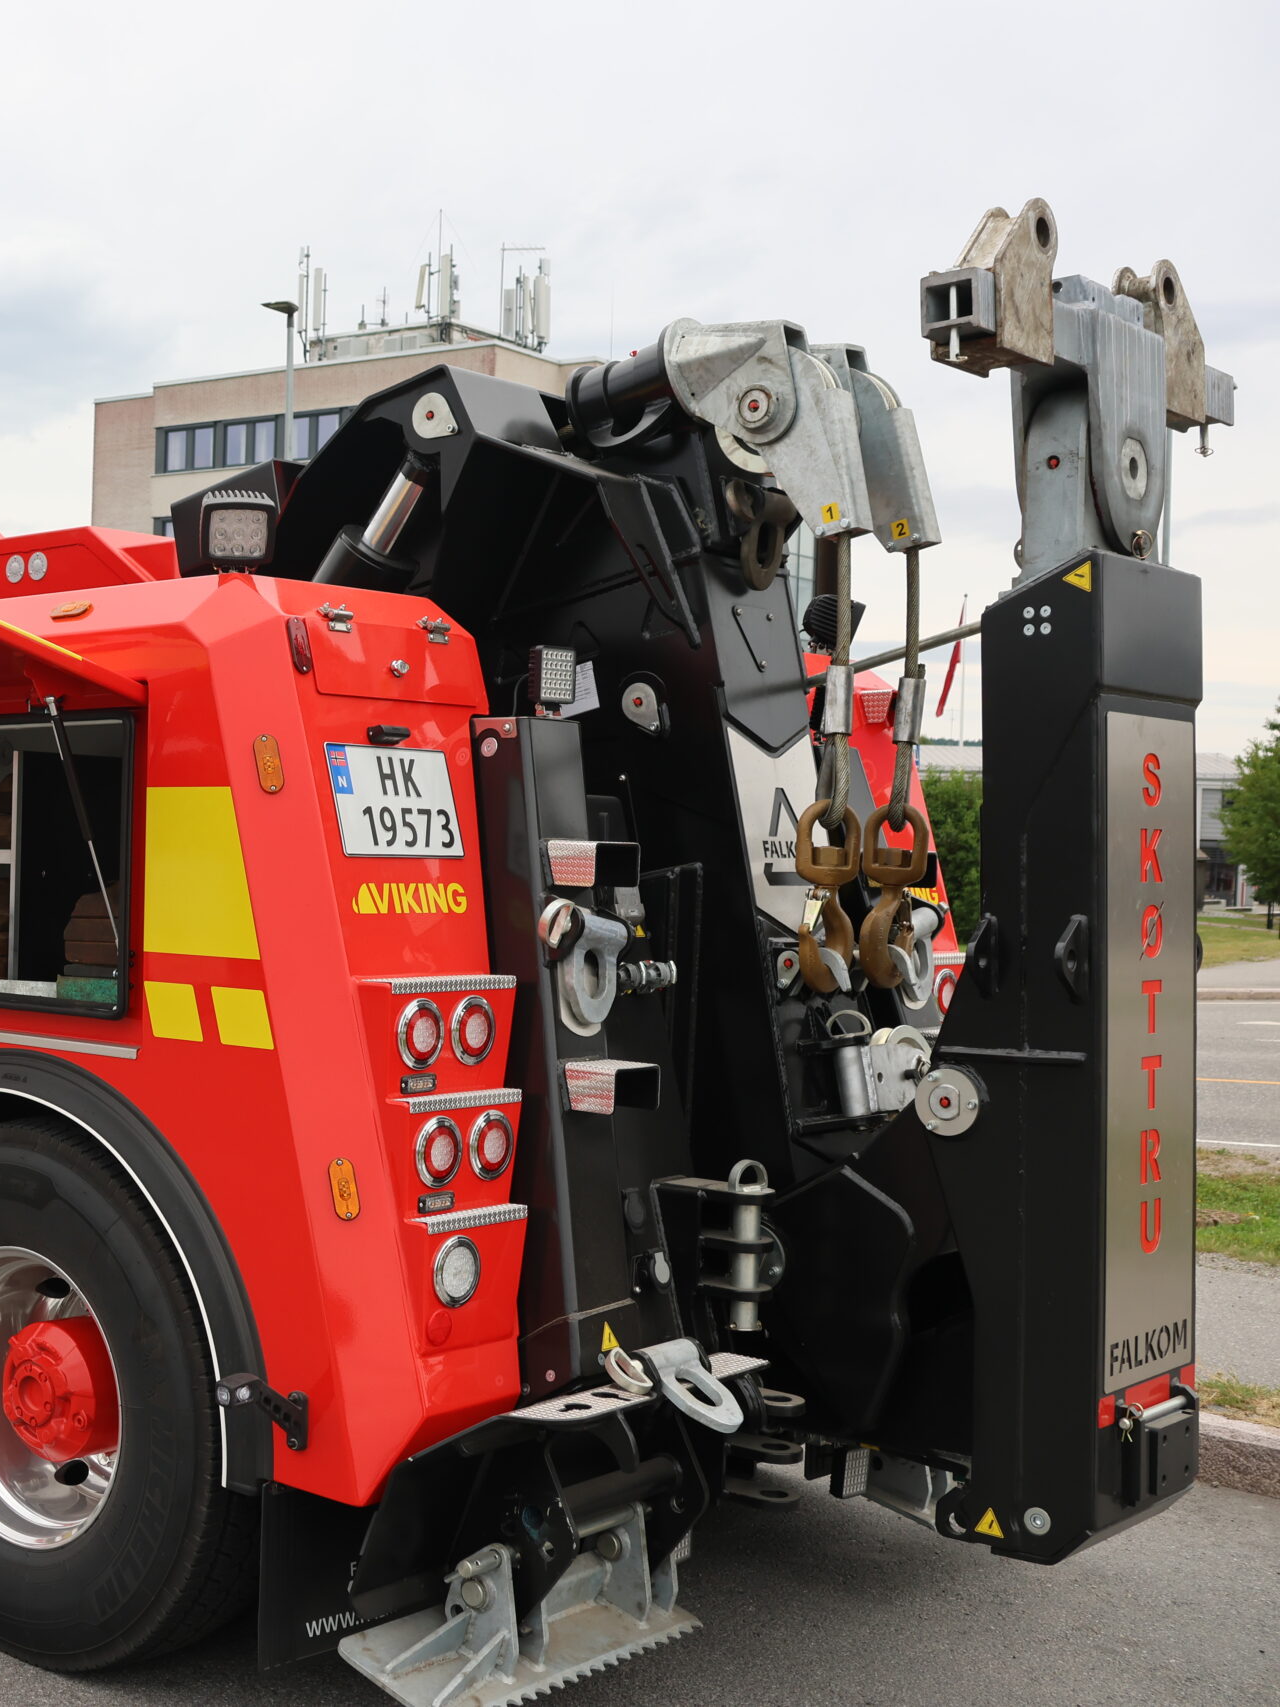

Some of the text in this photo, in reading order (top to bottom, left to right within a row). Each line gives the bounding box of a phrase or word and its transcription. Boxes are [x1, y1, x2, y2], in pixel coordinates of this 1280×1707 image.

[826, 506, 834, 520] 1
[896, 522, 906, 537] 2
[337, 775, 348, 788] N
[376, 756, 423, 798] HK
[362, 805, 455, 849] 19573
[762, 840, 797, 859] FALK
[369, 882, 468, 914] VIKING
[1139, 752, 1165, 1254] SKØTTRU
[1109, 1318, 1188, 1377] FALKOM
